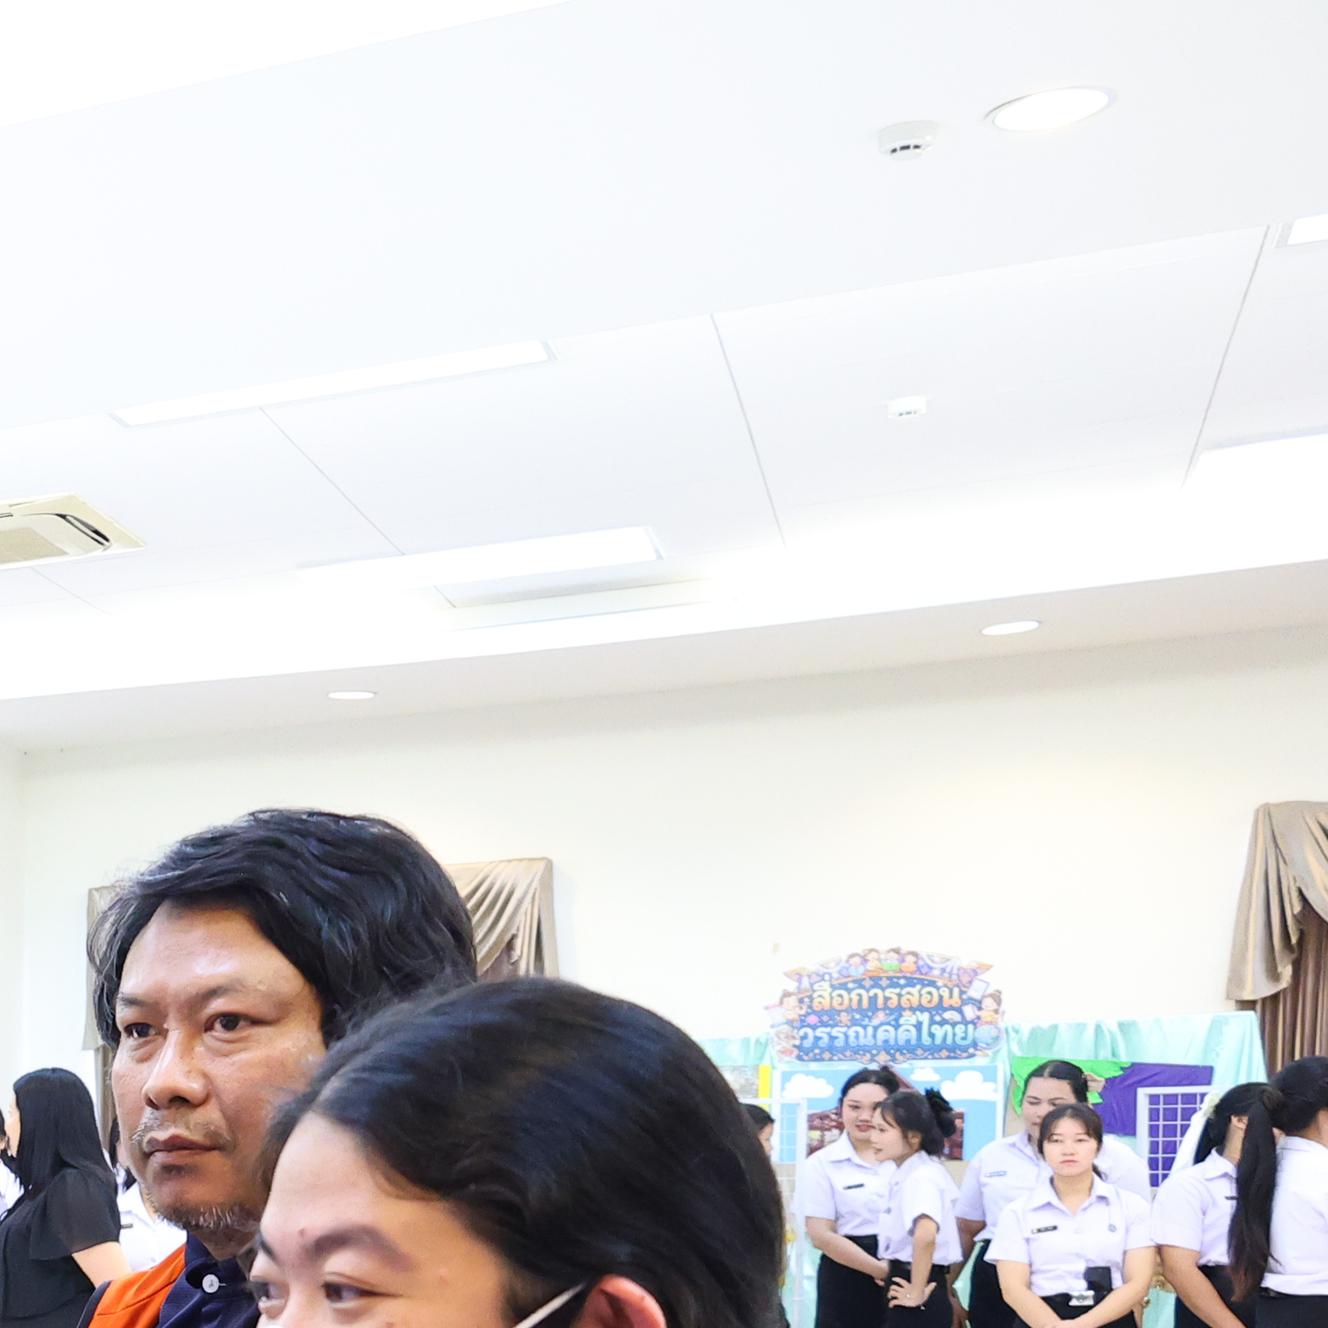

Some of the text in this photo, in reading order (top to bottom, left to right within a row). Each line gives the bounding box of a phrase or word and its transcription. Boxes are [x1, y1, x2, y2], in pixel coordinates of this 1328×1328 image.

[811, 974, 961, 1011] สื่อการสอน
[798, 1010, 976, 1048] วรรณคดีไทย
